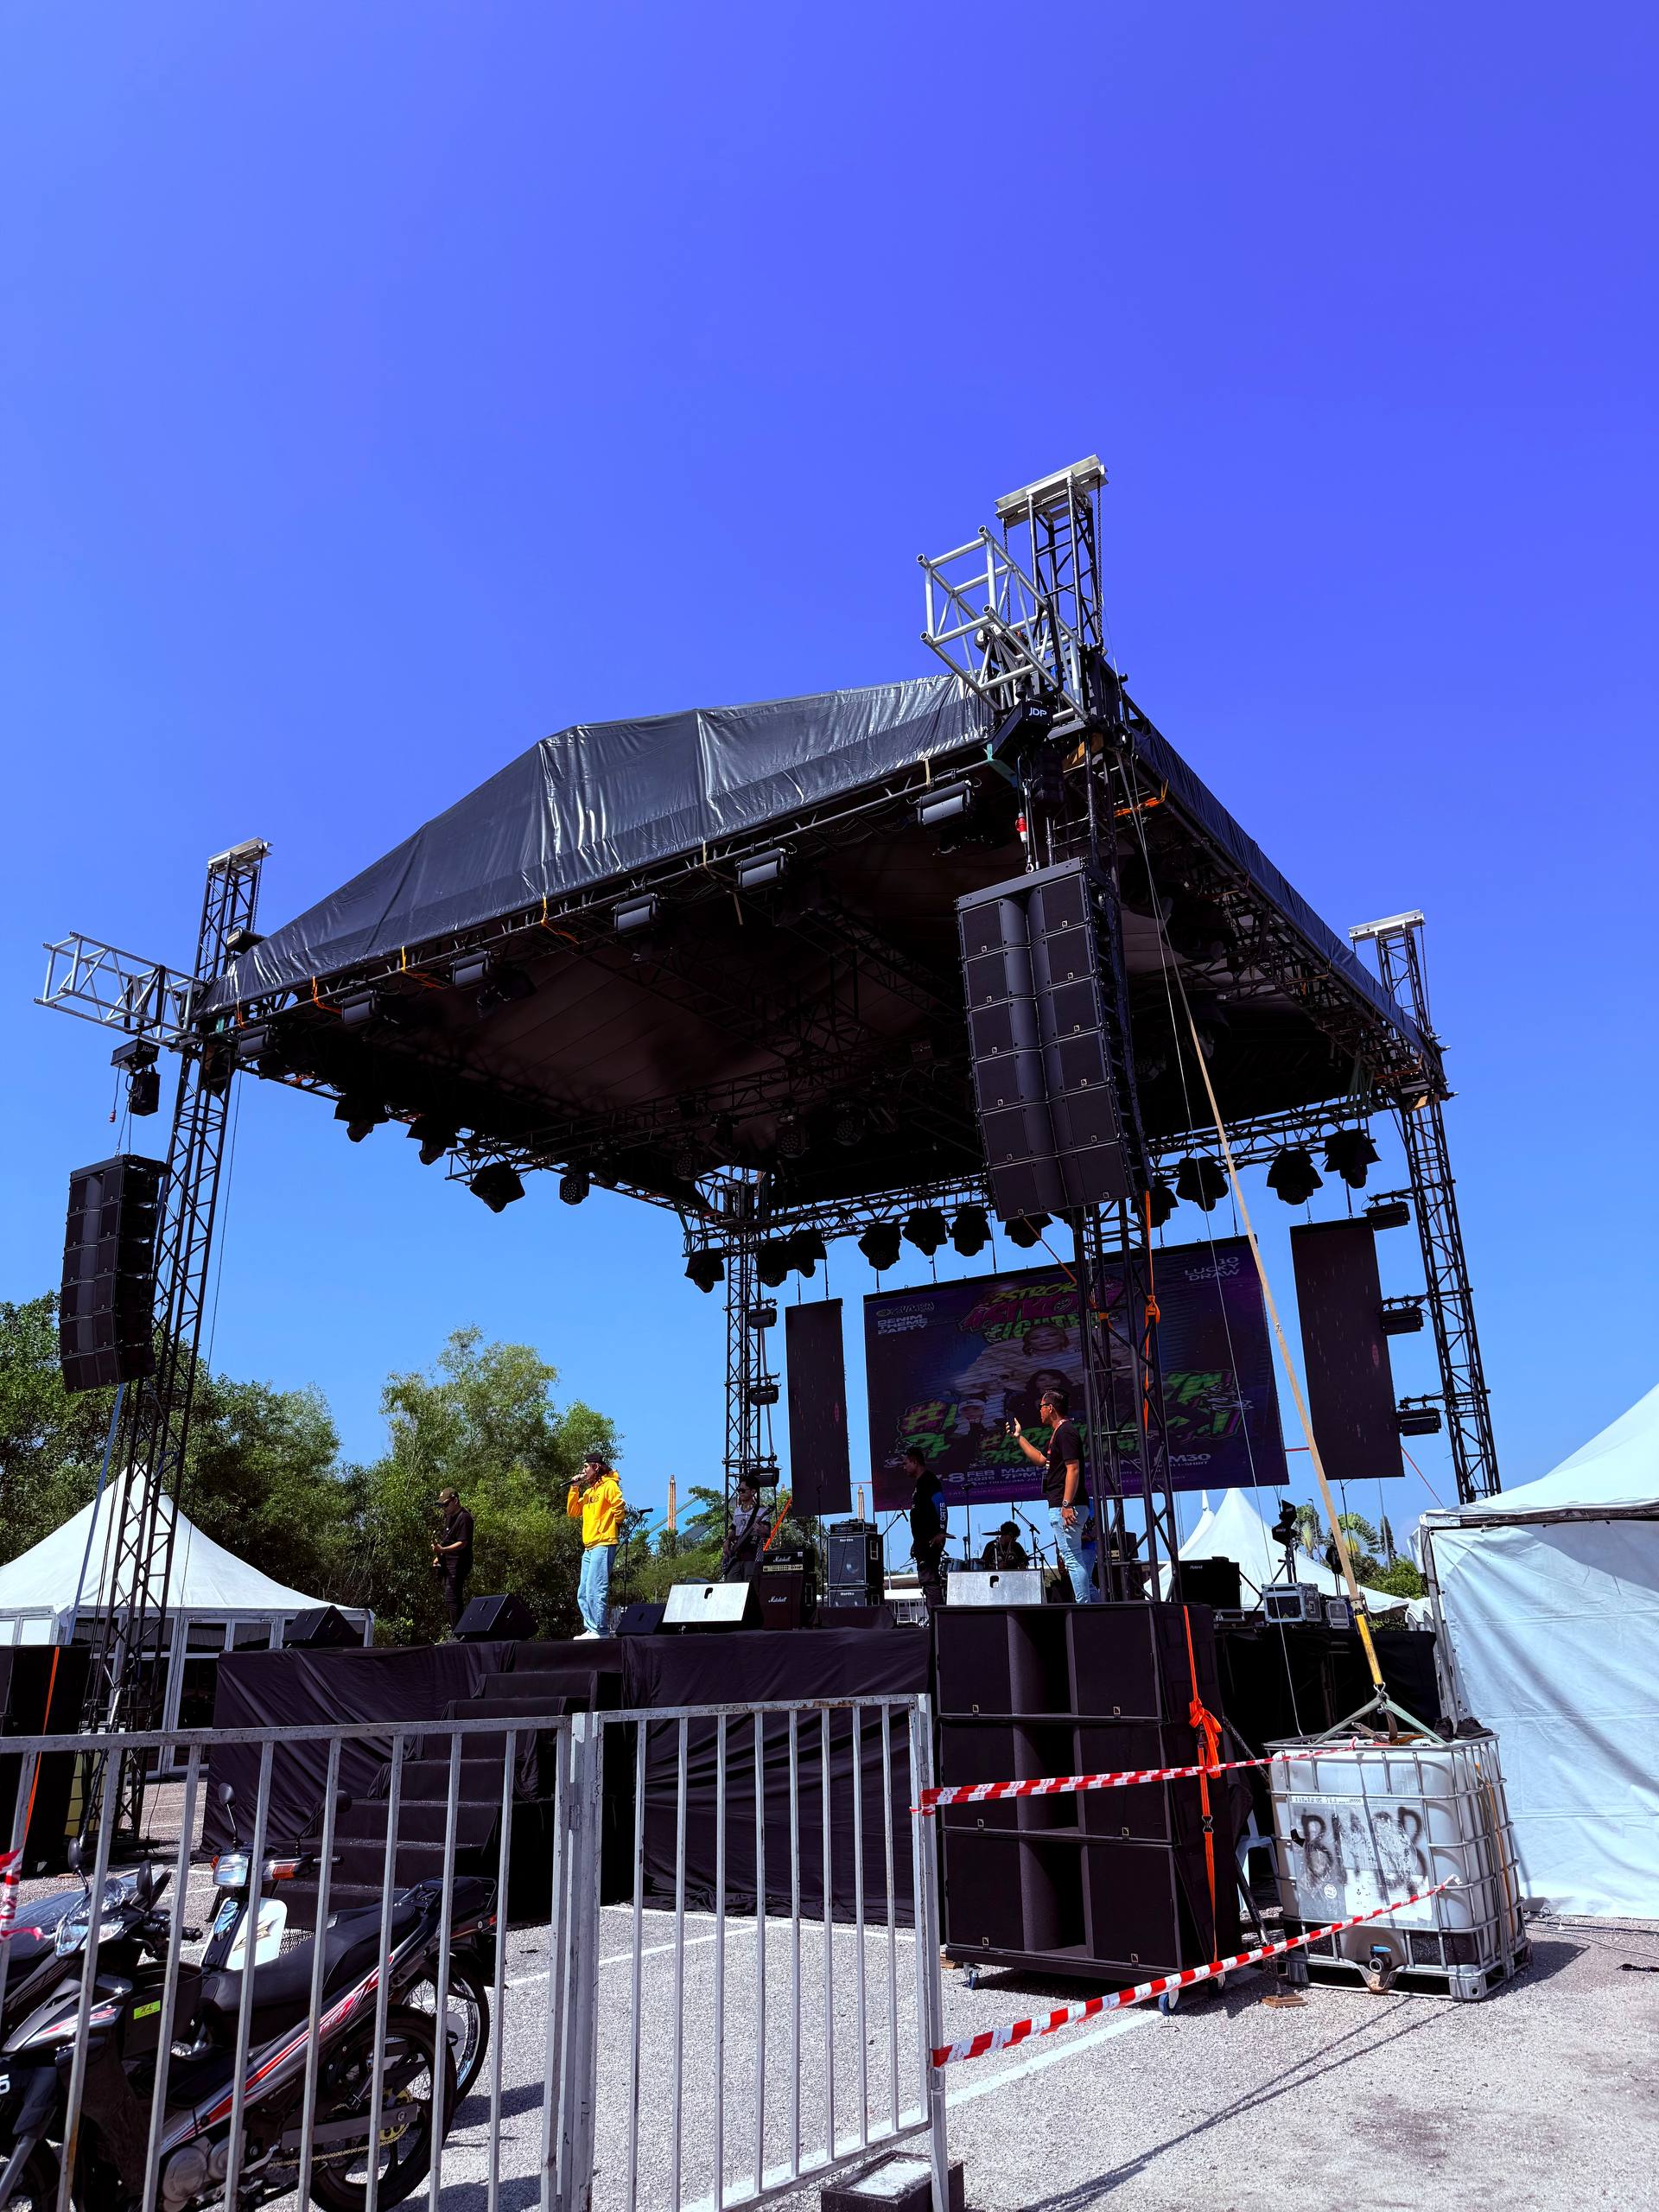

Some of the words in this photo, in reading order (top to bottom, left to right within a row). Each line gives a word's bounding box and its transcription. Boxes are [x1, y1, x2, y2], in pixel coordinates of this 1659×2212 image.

[1028, 707, 1047, 717] JDP
[141, 1045, 155, 1053] JDP
[1184, 1262, 1241, 1275] LUCKY
[1188, 1268, 1241, 1281] DRAW
[877, 1314, 923, 1325] DENIM
[877, 1318, 927, 1330] THEME
[877, 1324, 927, 1335] PARTY
